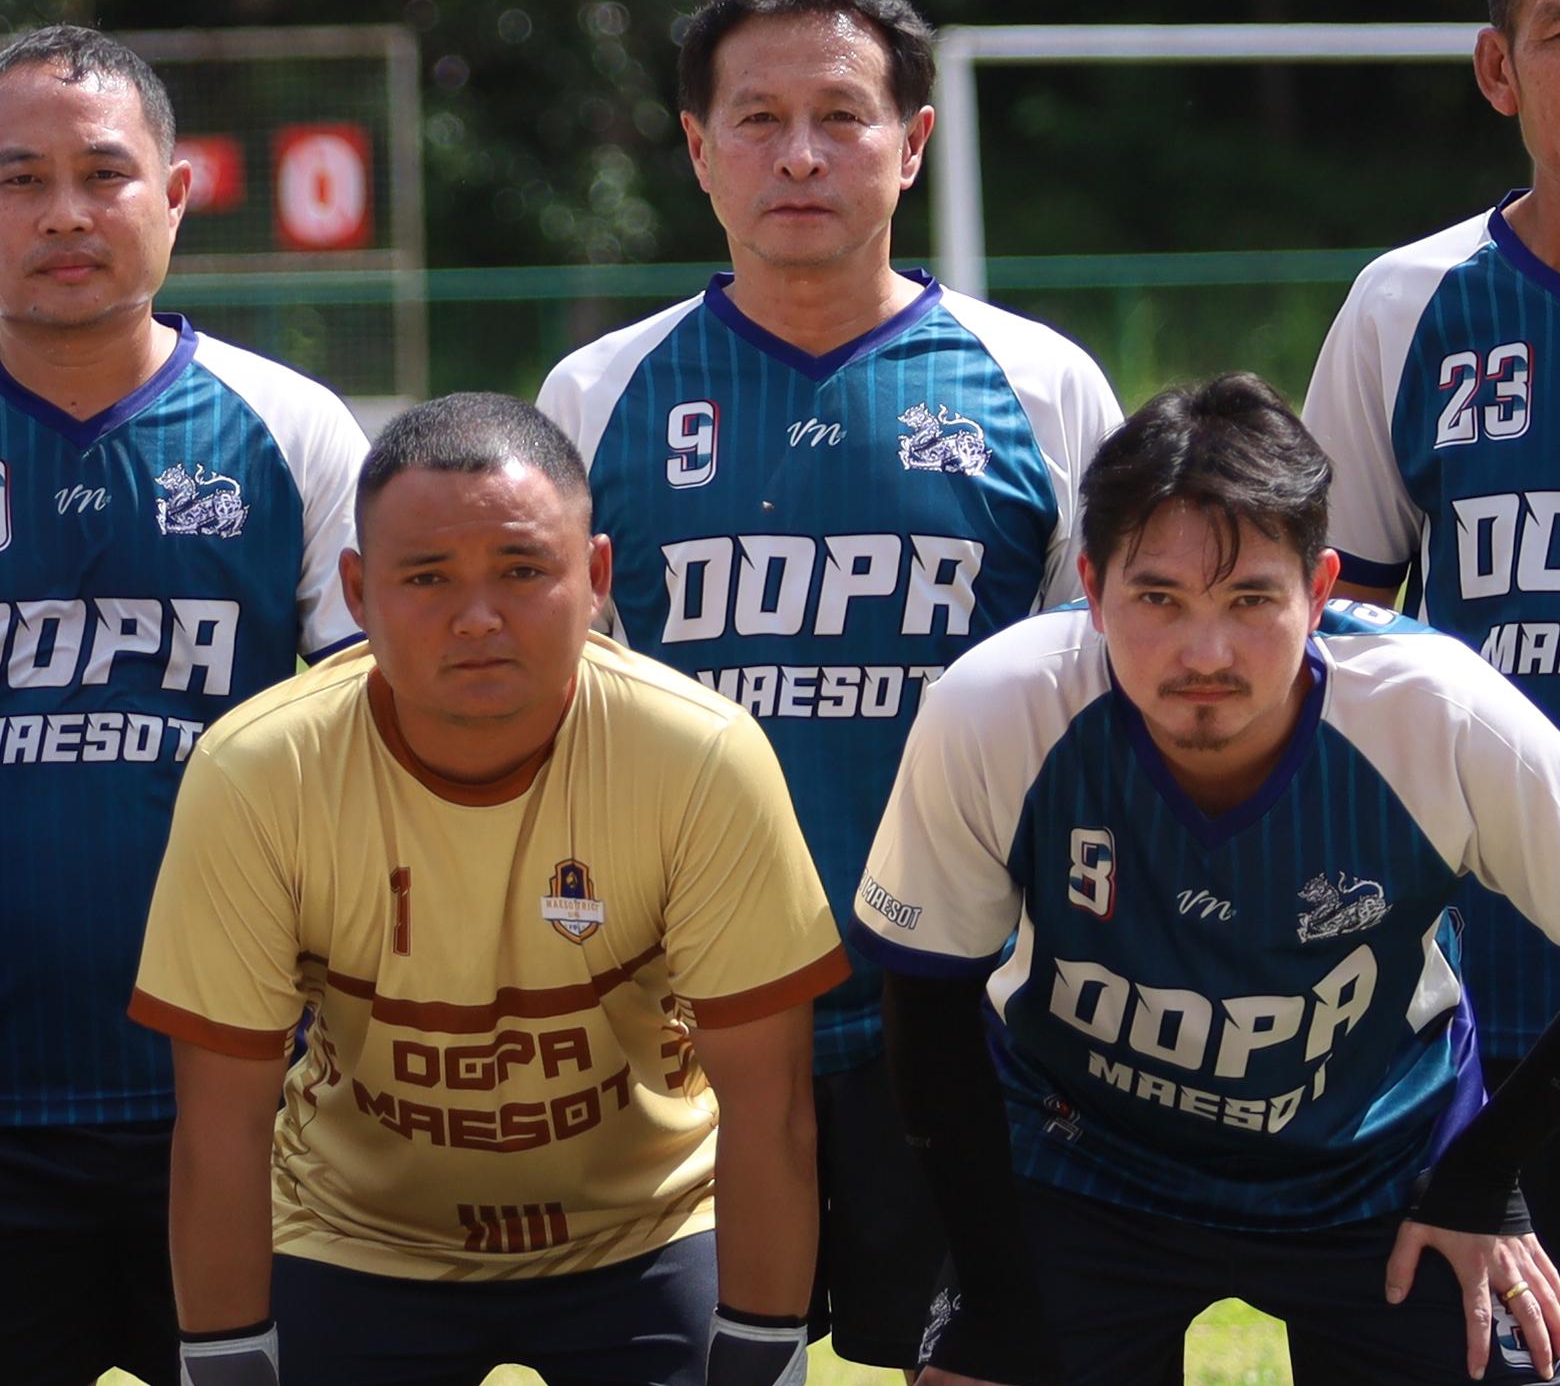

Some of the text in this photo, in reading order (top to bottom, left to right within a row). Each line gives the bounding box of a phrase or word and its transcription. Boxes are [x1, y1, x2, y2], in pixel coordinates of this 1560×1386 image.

[278, 133, 366, 245] 0
[667, 399, 720, 488] 9
[1434, 341, 1534, 449] 23
[661, 534, 983, 644] DOPA
[389, 865, 413, 957] 1
[1068, 826, 1118, 921] 8
[1051, 945, 1378, 1081] DOPA
[352, 1066, 633, 1154] MAESOT
